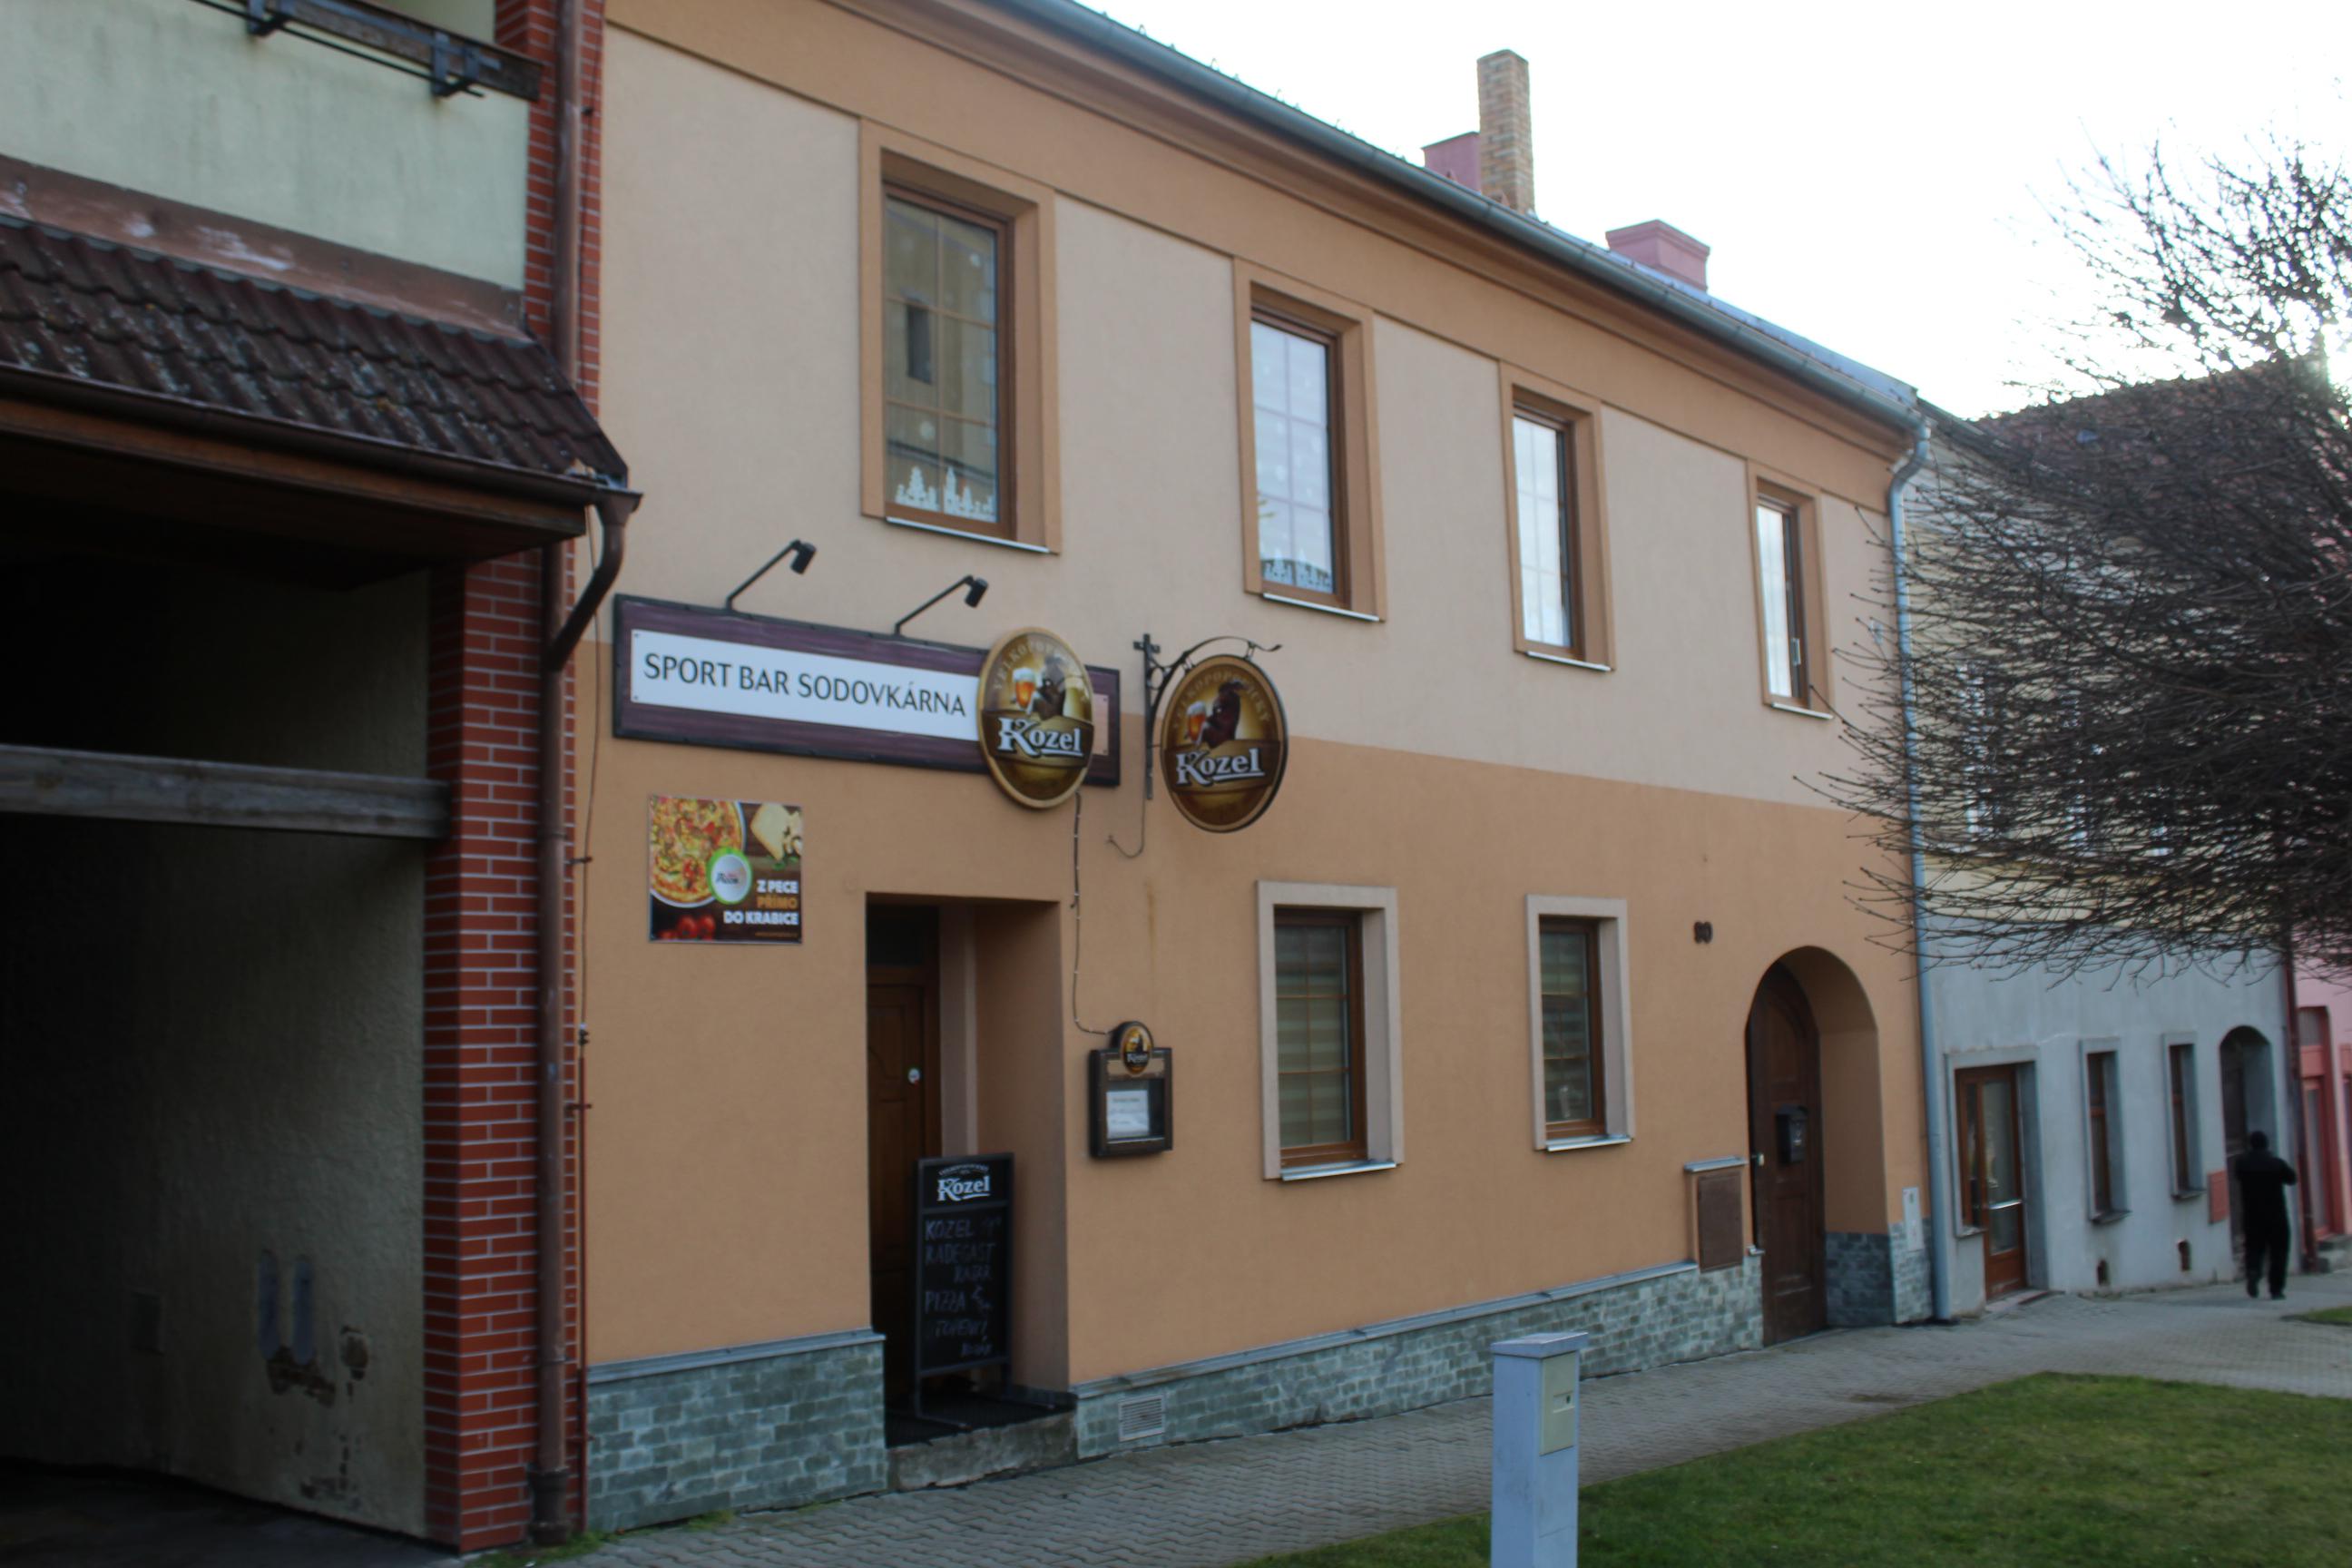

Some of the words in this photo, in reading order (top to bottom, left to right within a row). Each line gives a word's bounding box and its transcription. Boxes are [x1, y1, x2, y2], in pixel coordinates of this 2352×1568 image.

[643, 652, 732, 687] SPORT
[740, 665, 789, 695] BAR
[798, 672, 966, 717] SODOVKÁRNA
[996, 716, 1084, 759] Kozel
[1175, 747, 1266, 786] Kozel
[757, 879, 766, 892] Z
[769, 880, 799, 894] PECE
[723, 911, 743, 924] DO
[745, 911, 799, 925] KRABICE
[936, 1175, 991, 1202] Kozel
[925, 1219, 975, 1241] KOZEL
